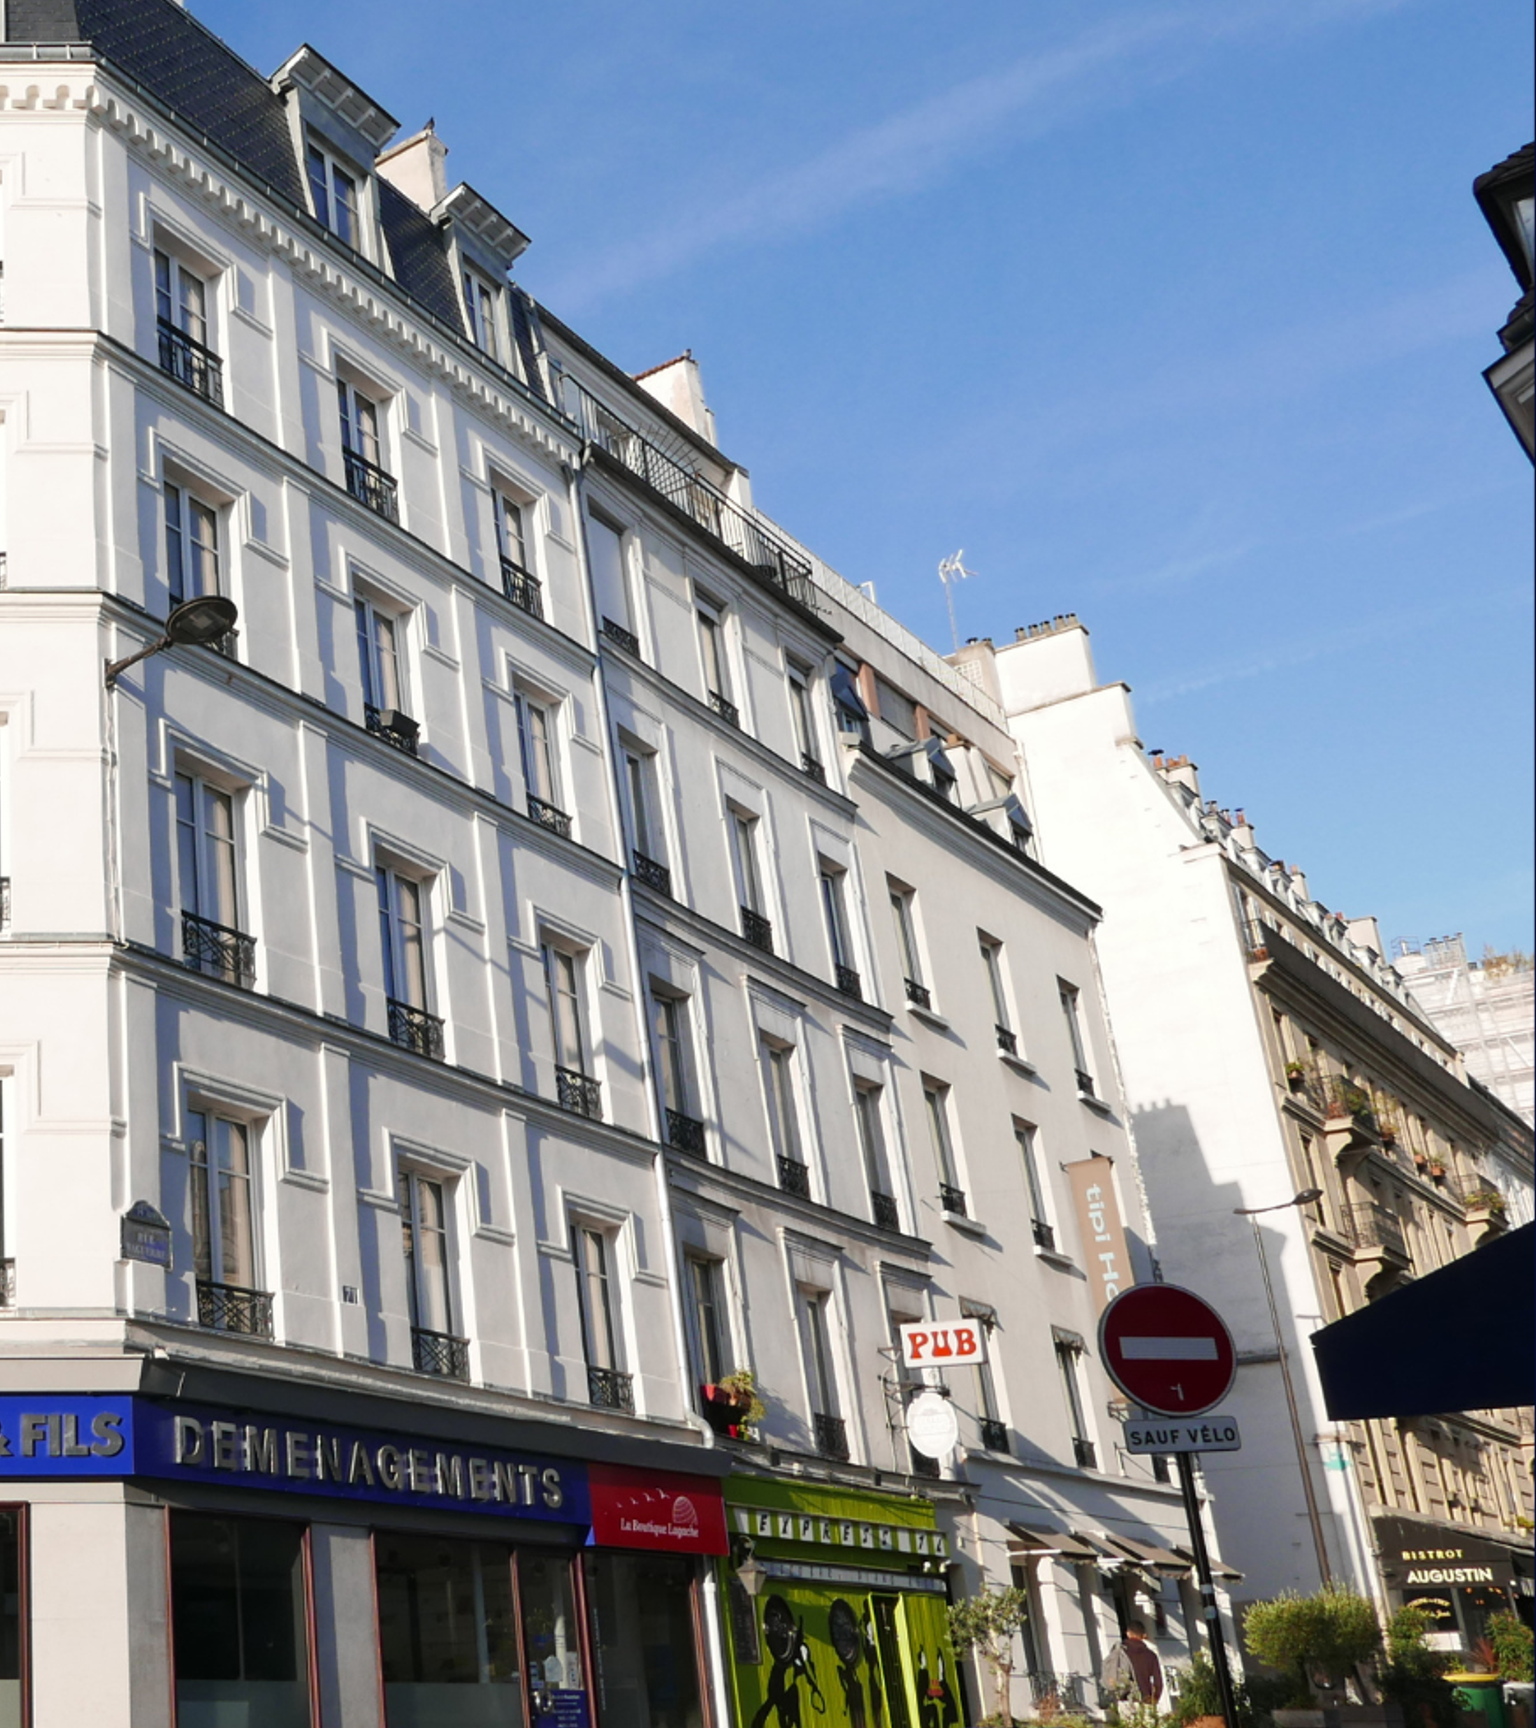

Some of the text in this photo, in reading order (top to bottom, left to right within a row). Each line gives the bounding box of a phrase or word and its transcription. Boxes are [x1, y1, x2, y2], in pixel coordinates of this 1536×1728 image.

[1086, 1184, 1111, 1242] tipi
[907, 1328, 976, 1360] PUB
[20, 1412, 125, 1458] FILS
[1130, 1425, 1236, 1446] SAUF VÉLO
[173, 1414, 564, 1509] DEMENAGEMENTS
[620, 1518, 632, 1532] La
[632, 1519, 667, 1538] Boutique
[759, 1513, 889, 1548] EXPRESS
[1402, 1548, 1463, 1561] BISTROT
[1406, 1567, 1493, 1584] AUGUSTIN
